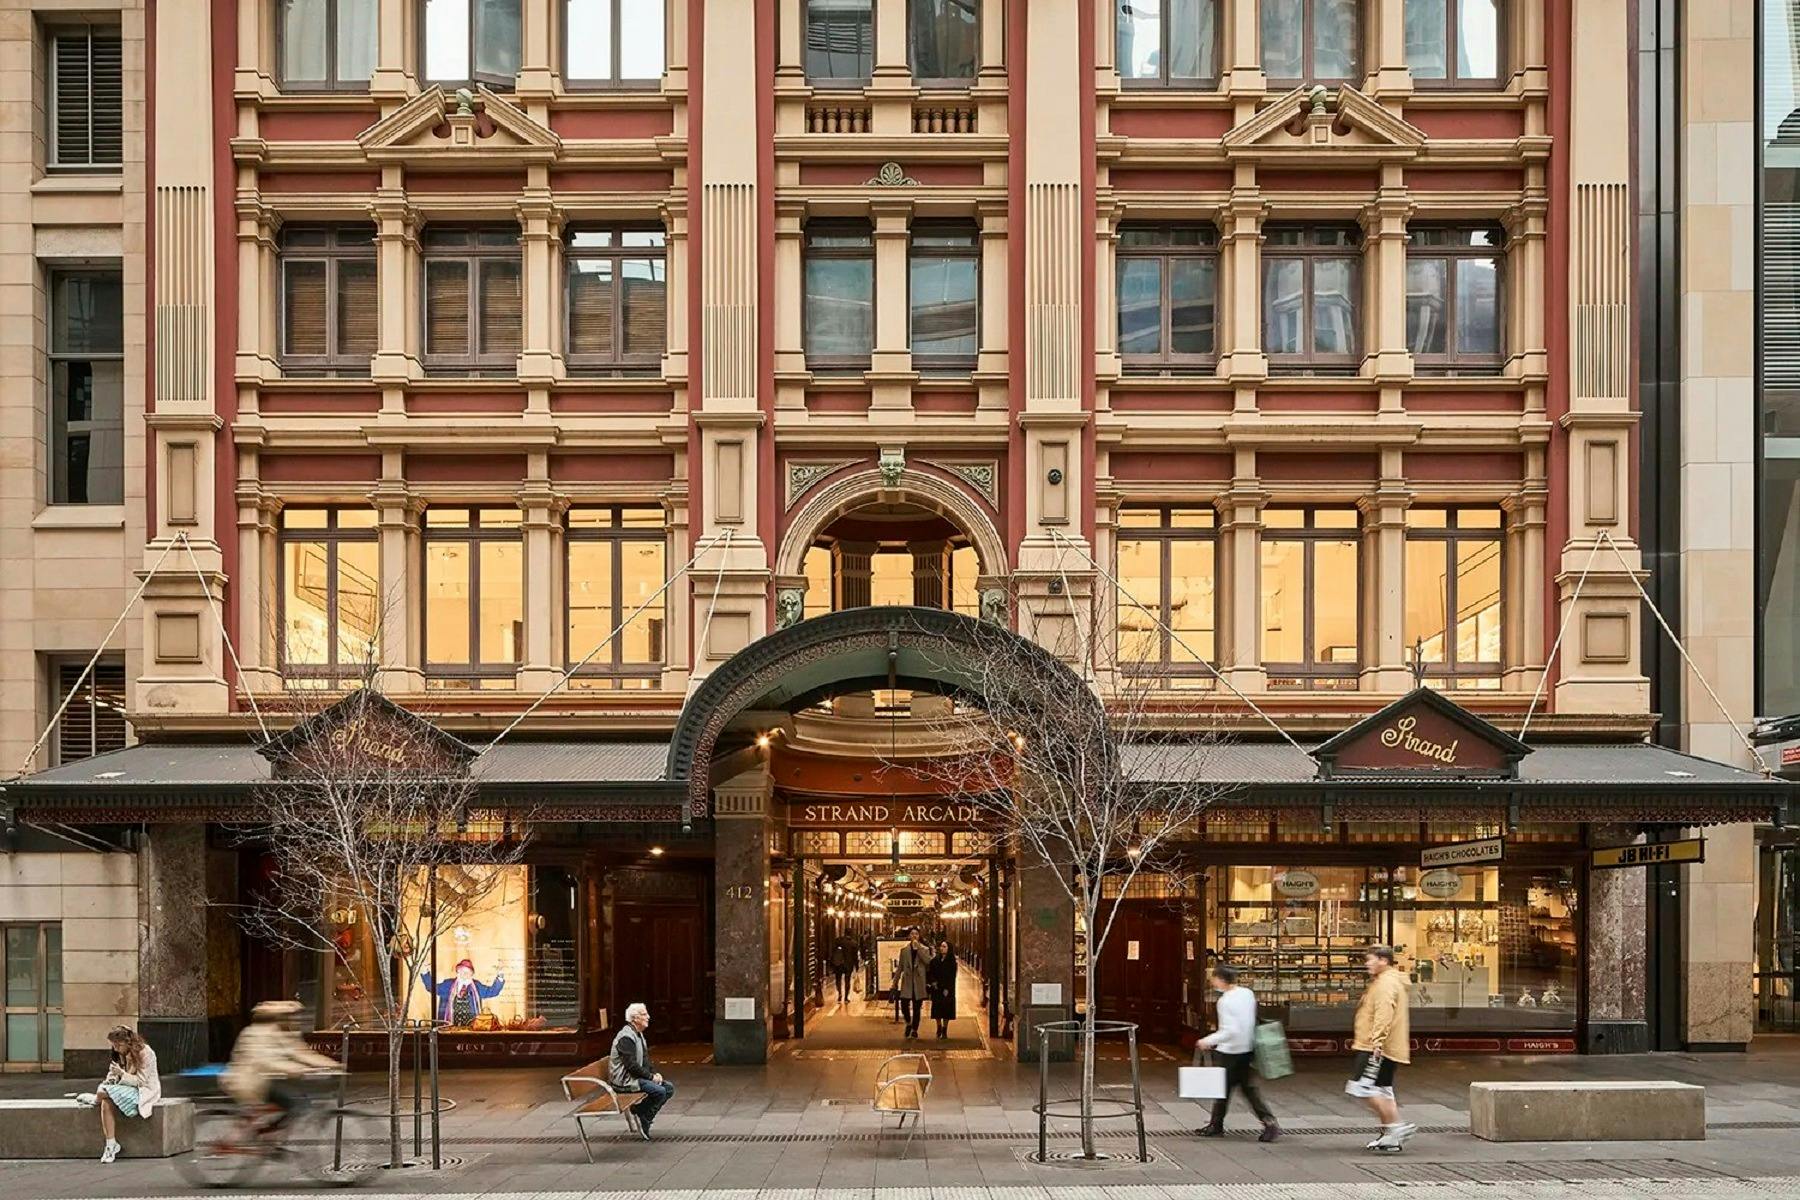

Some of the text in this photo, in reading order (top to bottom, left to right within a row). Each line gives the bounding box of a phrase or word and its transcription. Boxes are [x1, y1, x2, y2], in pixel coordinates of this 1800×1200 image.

[331, 717, 409, 763] Srand
[1381, 716, 1459, 763] Strand
[804, 805, 985, 822] STRAND ARCADE
[1451, 845, 1500, 859] CHOCOLATES
[1618, 845, 1670, 863] JB HI-FI
[726, 886, 752, 899] 412
[1282, 880, 1314, 888] HAIGH'S
